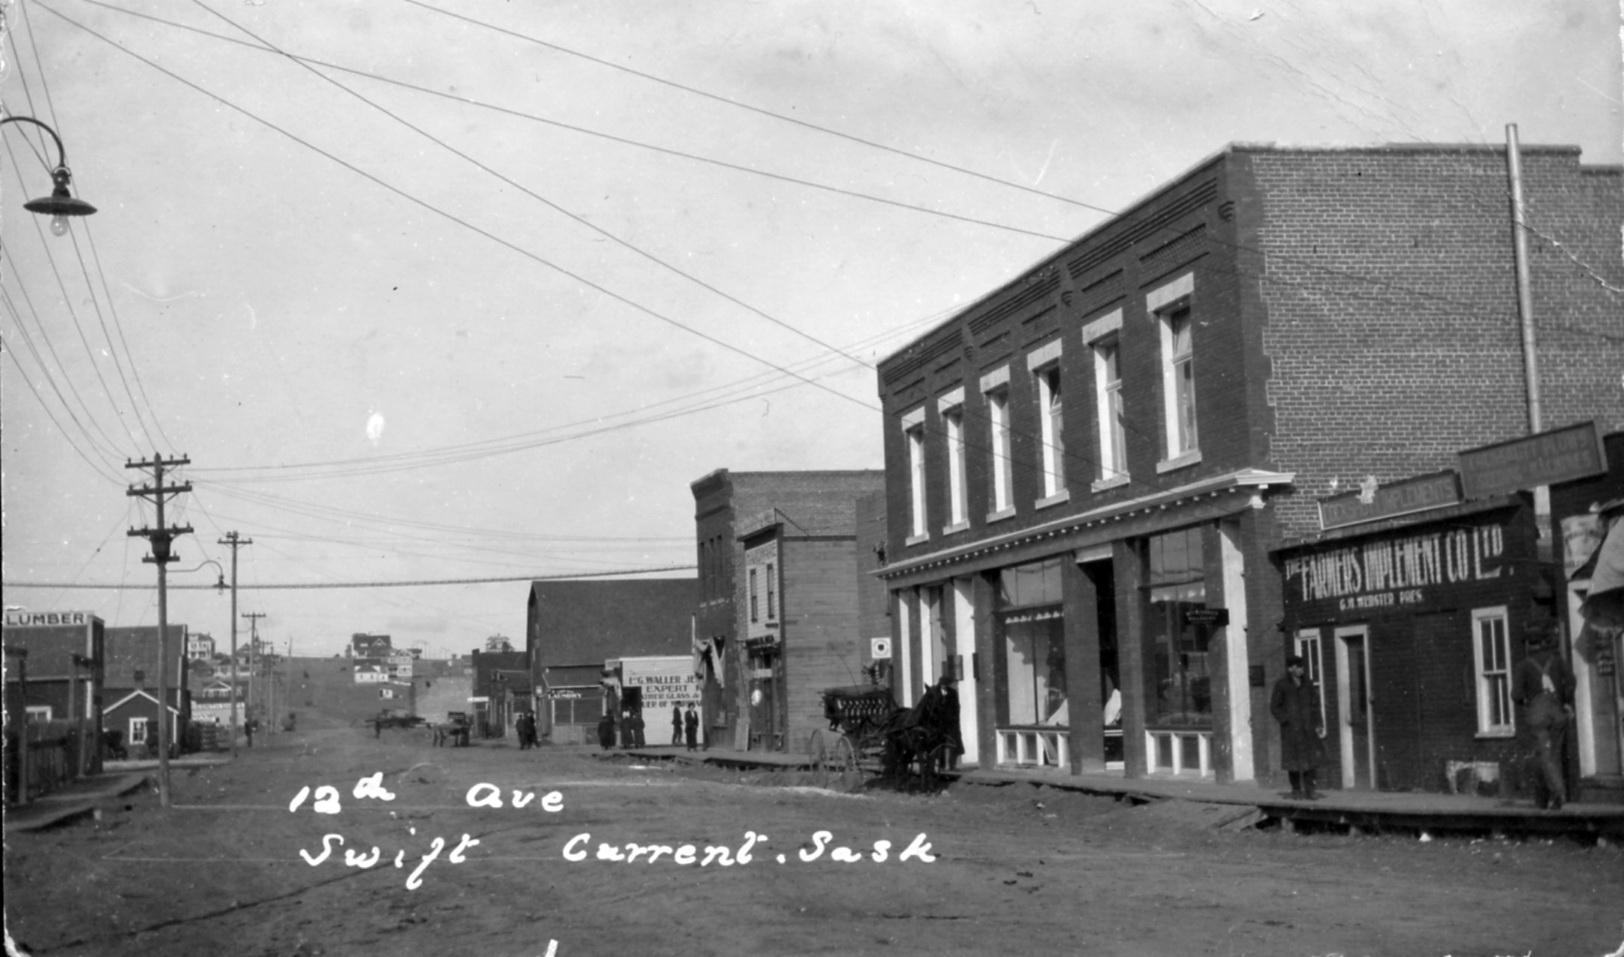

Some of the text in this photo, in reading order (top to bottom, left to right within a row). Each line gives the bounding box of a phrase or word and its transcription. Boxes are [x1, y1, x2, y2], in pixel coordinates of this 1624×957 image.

[1363, 532, 1441, 592] IMPLEMENT
[1446, 528, 1468, 583] CO
[5, 613, 84, 626] LUMBER
[646, 684, 688, 693] EXPERT
